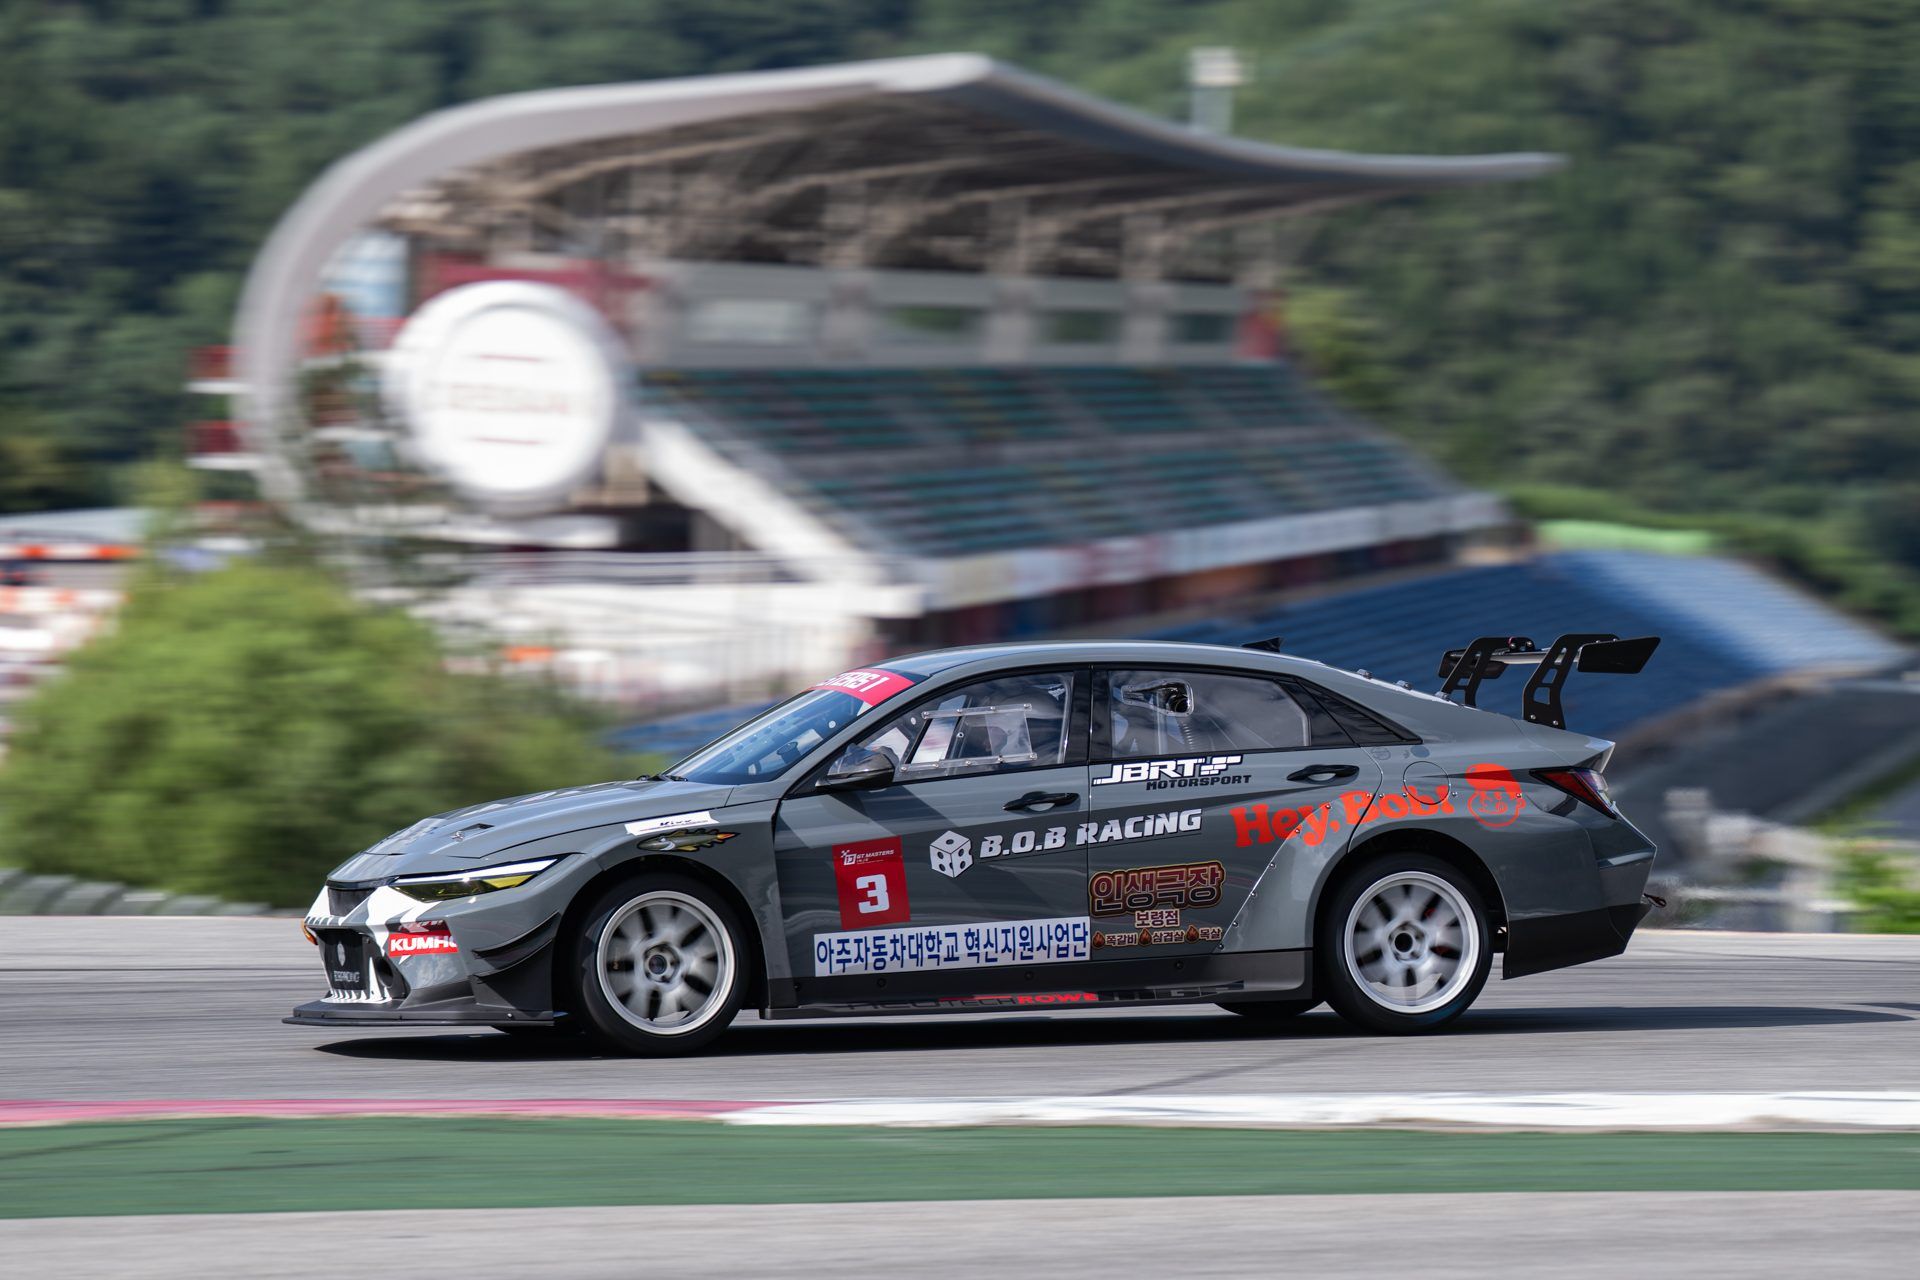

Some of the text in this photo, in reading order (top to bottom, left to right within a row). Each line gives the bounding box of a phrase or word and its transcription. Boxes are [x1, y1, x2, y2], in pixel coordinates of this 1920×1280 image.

[1146, 774, 1252, 791] MOTORSPORT
[1229, 784, 1455, 848] Hey, Bob!
[979, 808, 1202, 859] B.O.B RACING
[865, 849, 895, 858] MASTERS
[856, 873, 890, 914] 3
[1093, 864, 1223, 912] 인생극장
[1136, 909, 1180, 928] 보령점
[816, 922, 1089, 975] 아주자동차대학교 혁신지원사업단
[1152, 931, 1185, 944] 삼겹살
[1199, 928, 1223, 940] 목살
[1017, 991, 1100, 1006] ROWE
